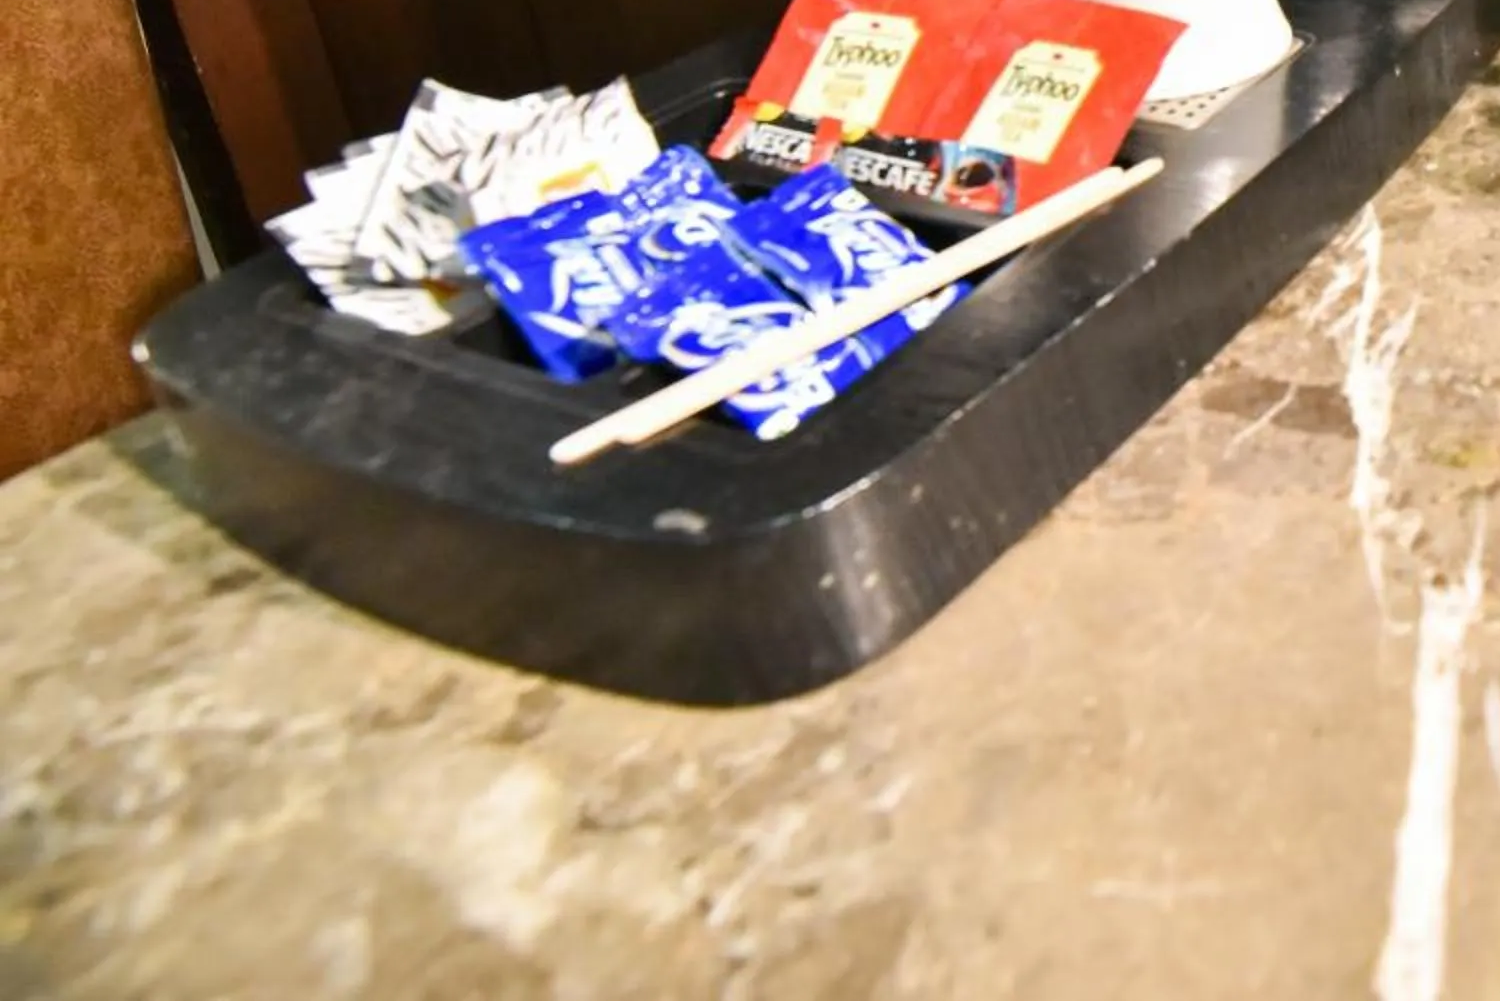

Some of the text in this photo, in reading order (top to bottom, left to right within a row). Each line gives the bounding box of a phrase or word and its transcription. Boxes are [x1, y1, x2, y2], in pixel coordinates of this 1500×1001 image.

[823, 35, 901, 69] Typhoo
[1000, 64, 1081, 102] Typhoo
[746, 122, 817, 166] NESCA
